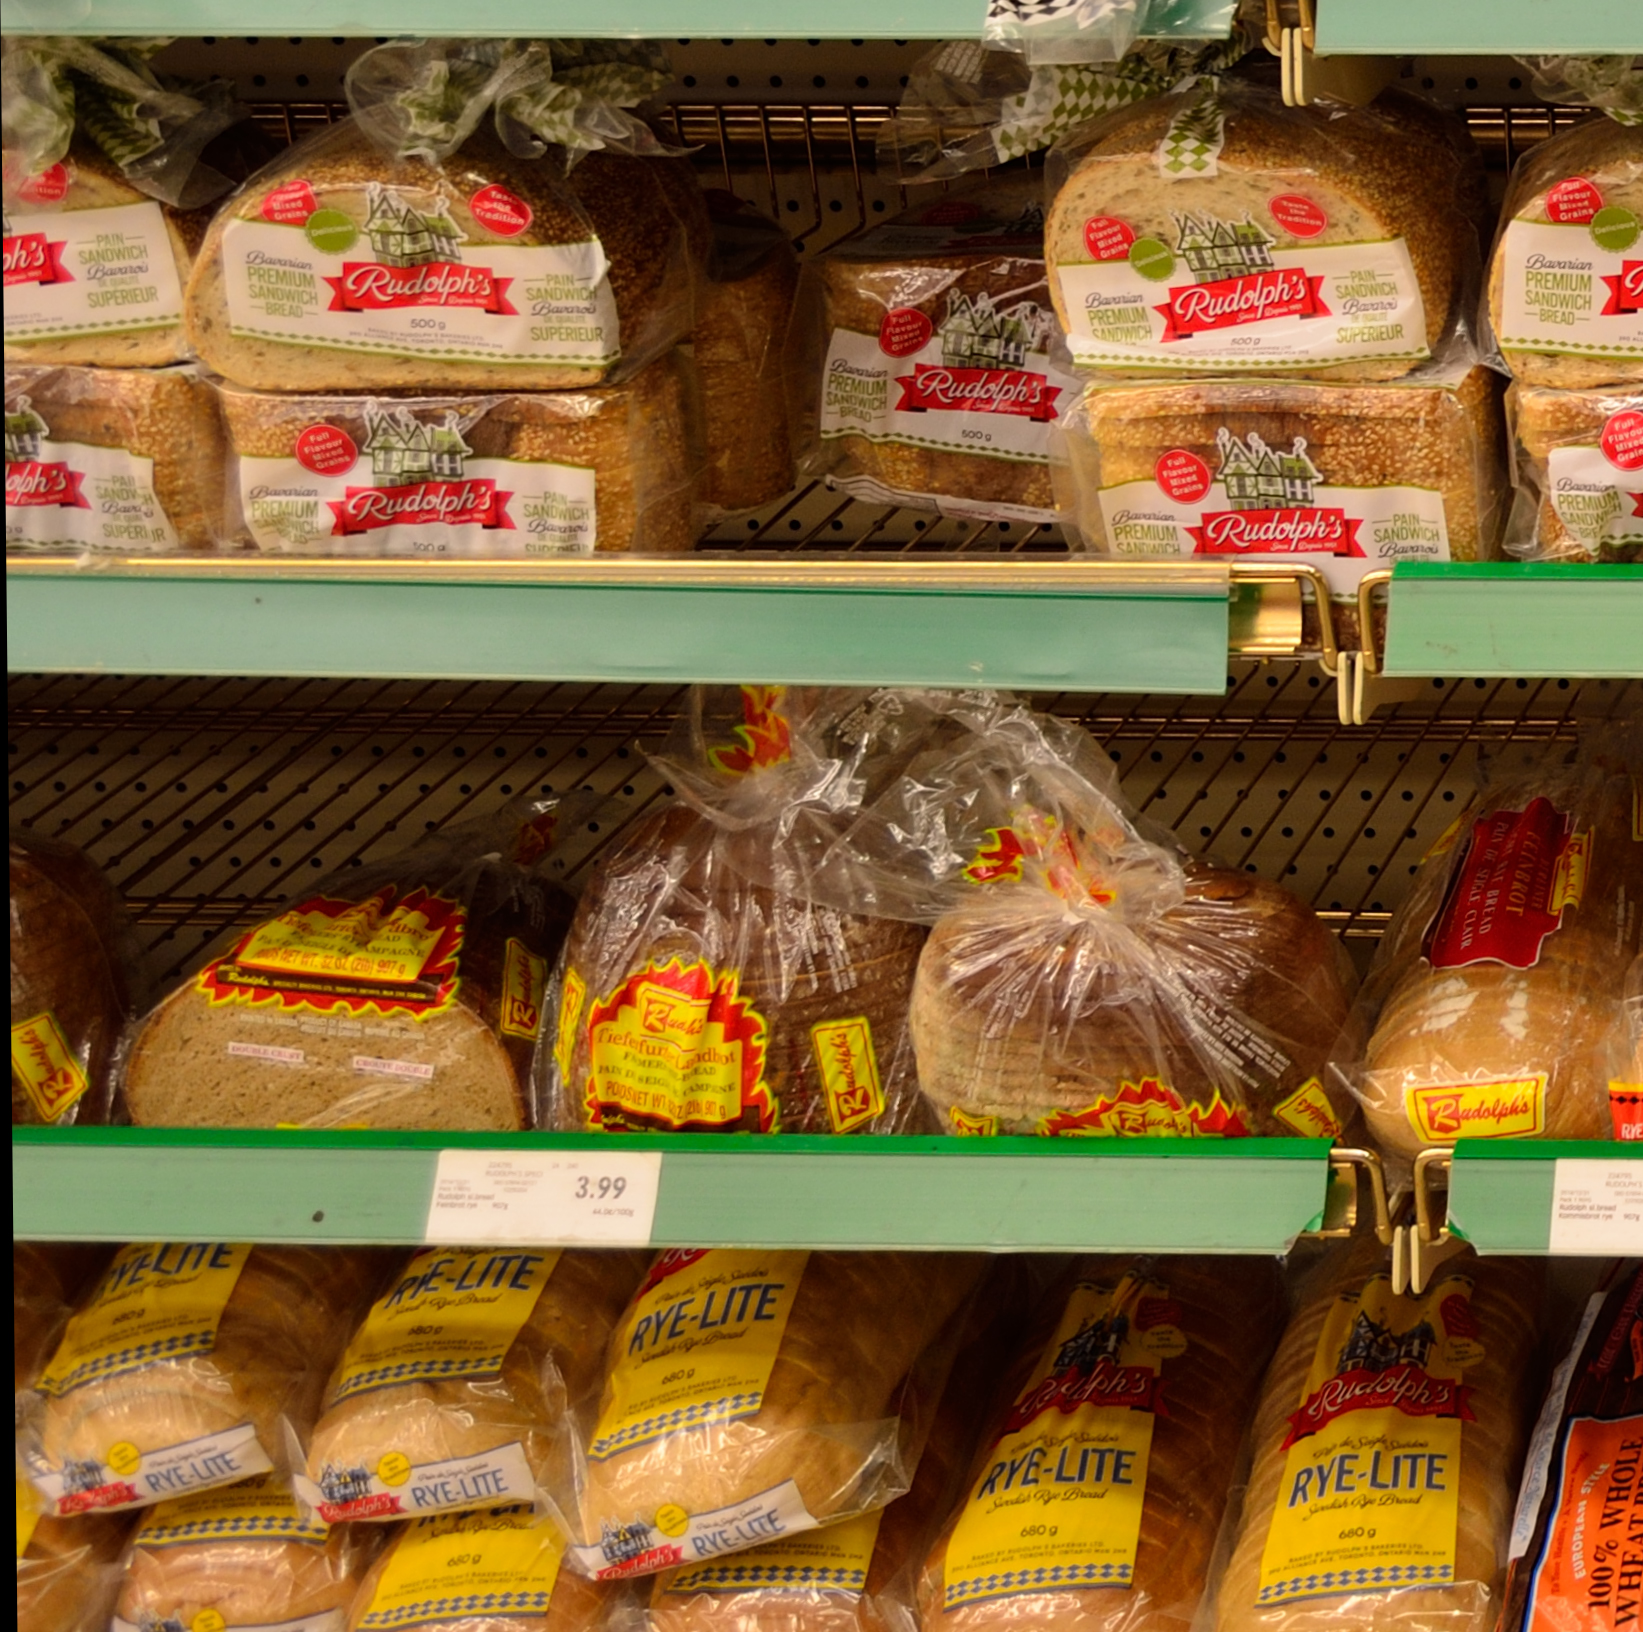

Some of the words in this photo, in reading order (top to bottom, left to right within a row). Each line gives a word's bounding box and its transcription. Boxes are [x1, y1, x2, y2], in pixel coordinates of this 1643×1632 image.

[247, 264, 315, 289] PREMIUM
[347, 264, 492, 303] Rudolph's
[575, 1175, 627, 1199] 3.99
[412, 1467, 509, 1512] RYE-LITE
[976, 1445, 1137, 1501] RYE-LITE
[1288, 1442, 1448, 1508] RYE-LITE
